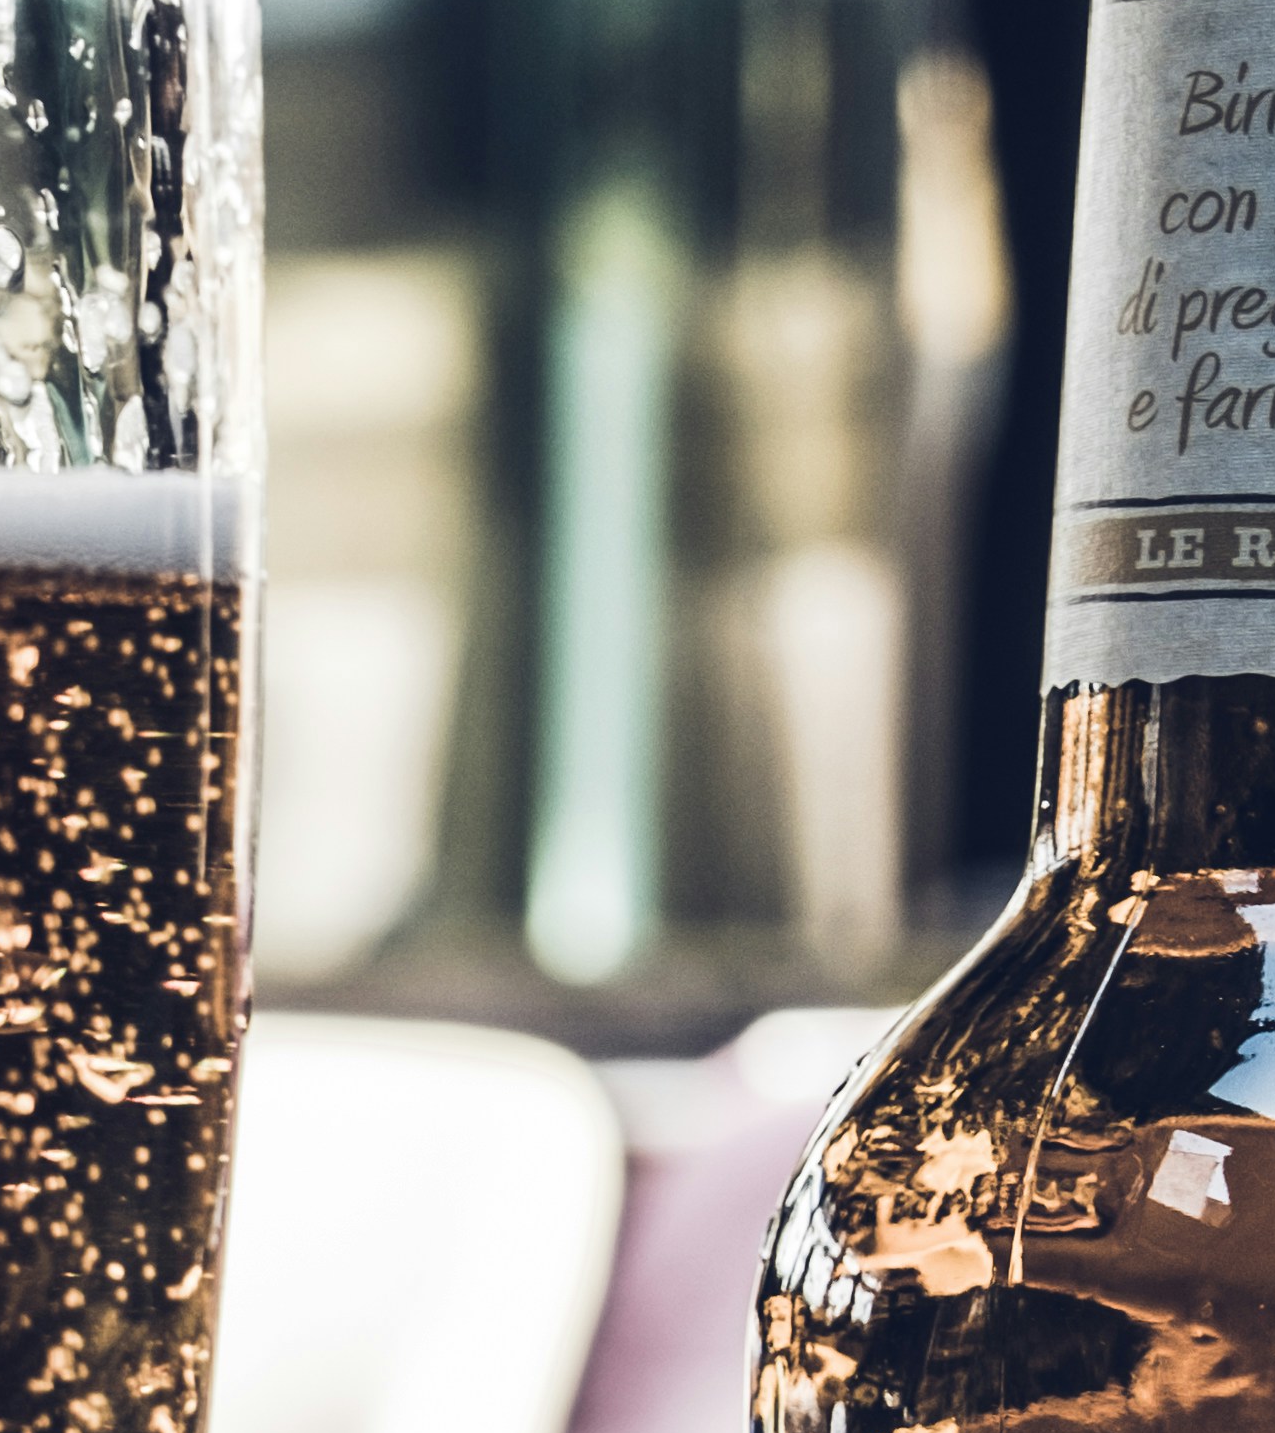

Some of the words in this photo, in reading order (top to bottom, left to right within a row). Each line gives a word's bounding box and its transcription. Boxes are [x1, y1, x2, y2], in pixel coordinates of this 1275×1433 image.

[1160, 185, 1257, 235] con
[1117, 256, 1165, 335] di
[1128, 389, 1159, 432] e
[1136, 527, 1205, 569] LE
